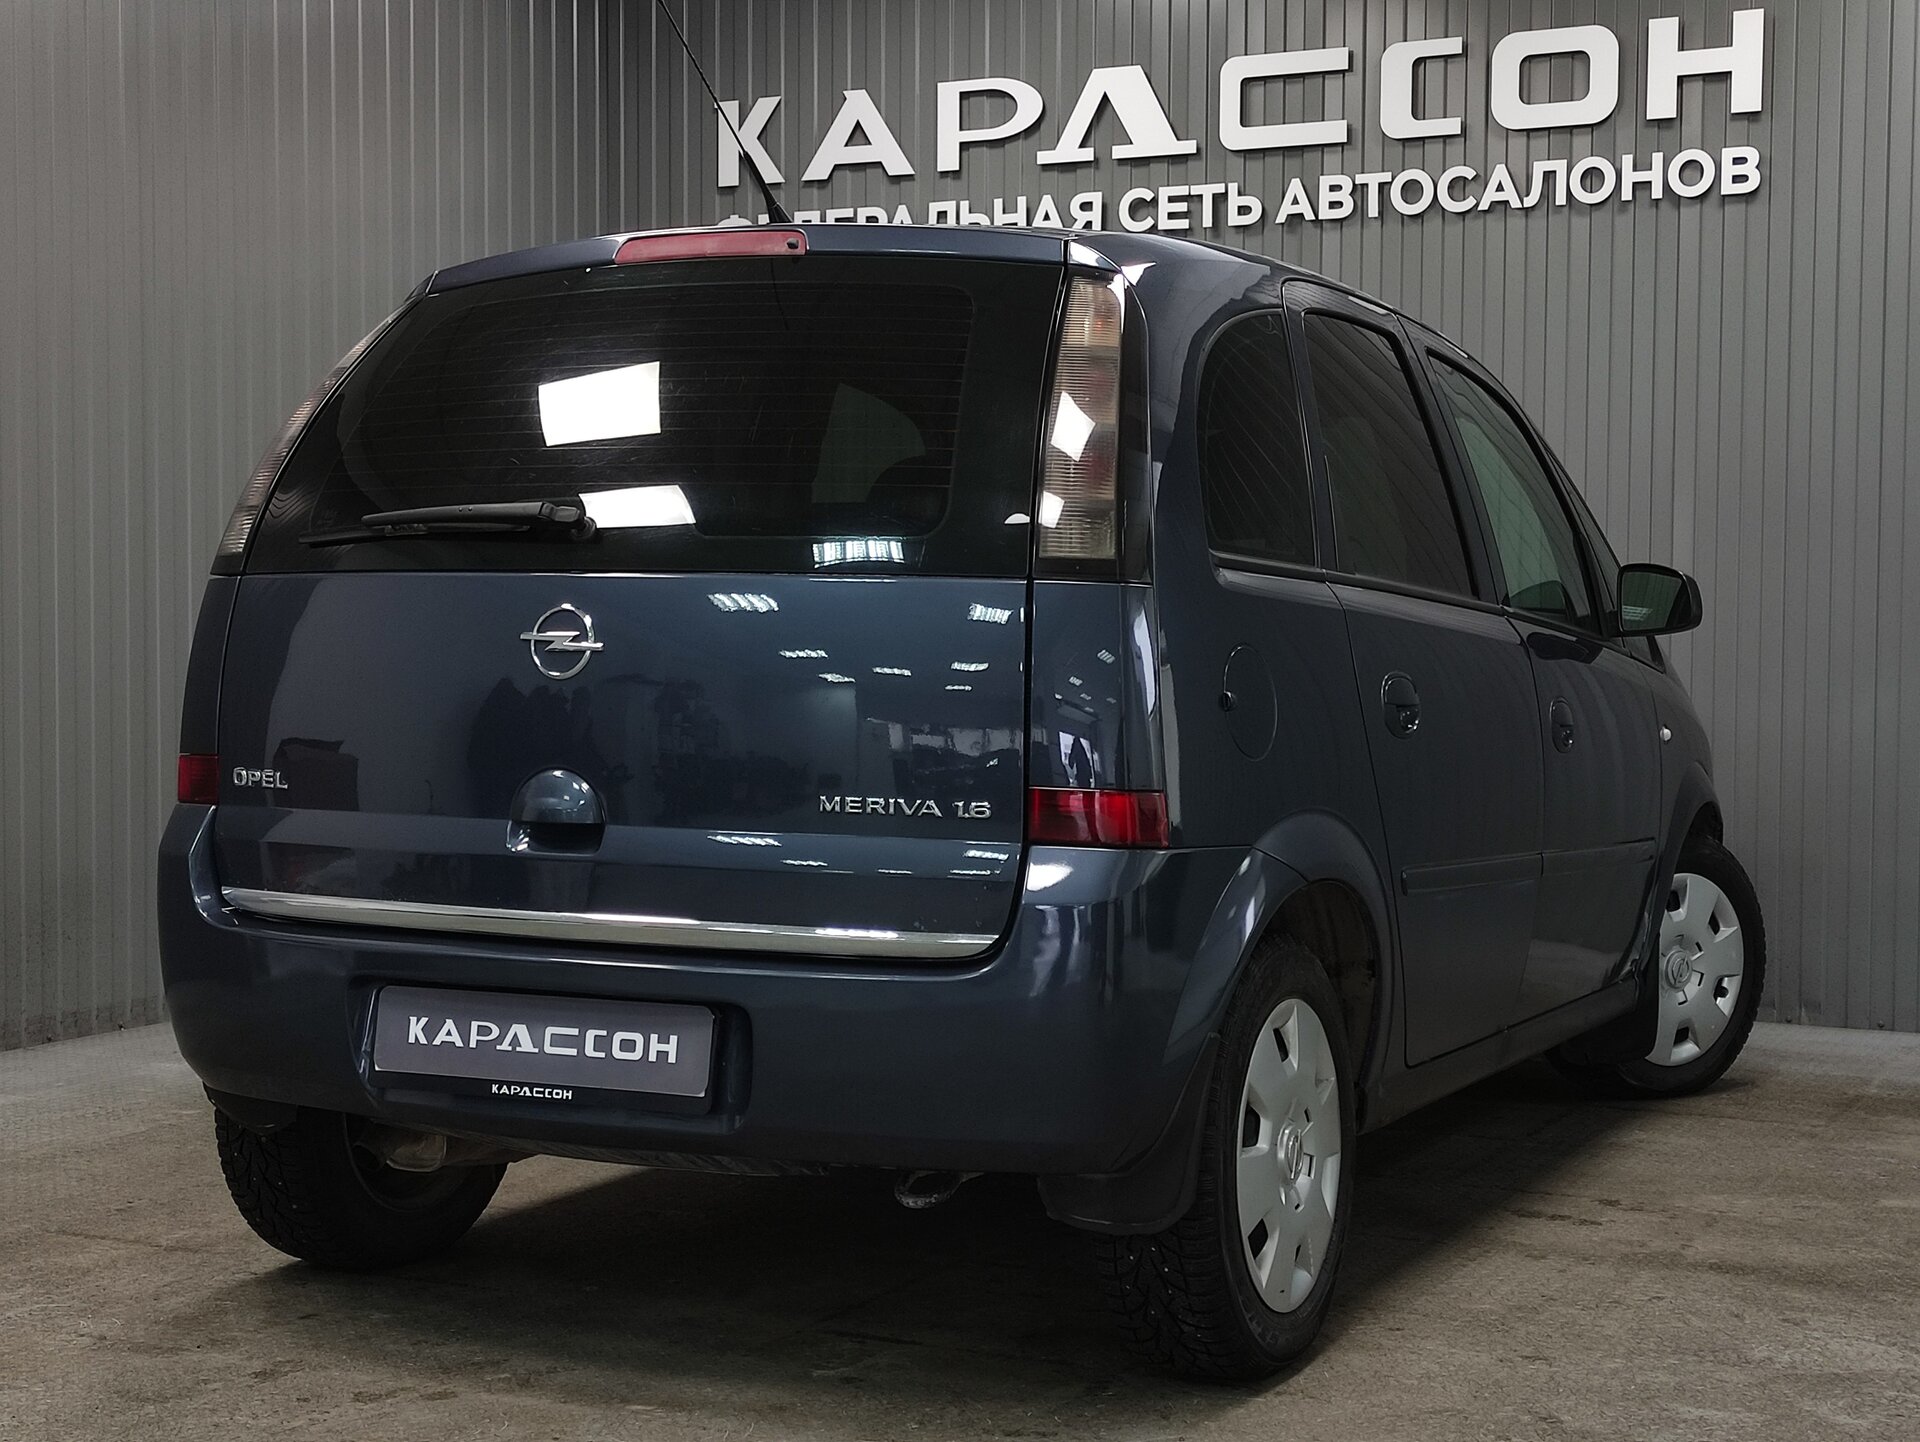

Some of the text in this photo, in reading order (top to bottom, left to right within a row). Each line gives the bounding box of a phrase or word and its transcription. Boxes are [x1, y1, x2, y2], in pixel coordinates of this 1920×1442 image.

[1118, 182, 1263, 233] СЕТЬ
[1275, 146, 1762, 224] АВТОСАЛОНОВ
[233, 766, 288, 789] OPEL
[819, 795, 943, 817] MERIVA
